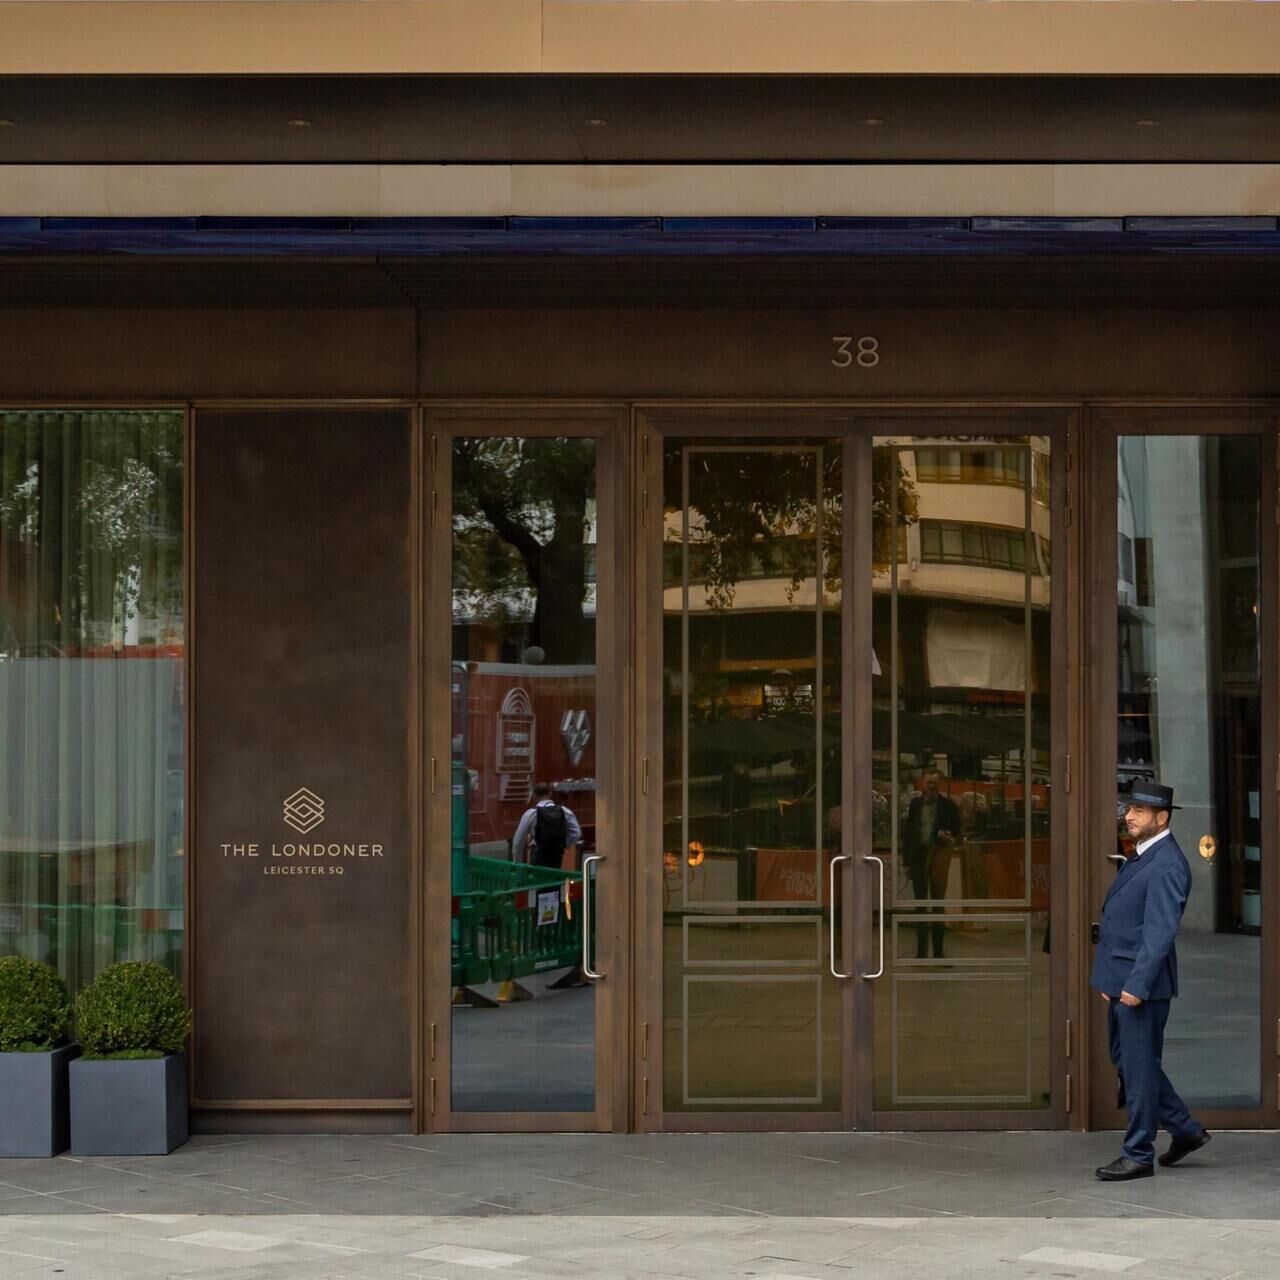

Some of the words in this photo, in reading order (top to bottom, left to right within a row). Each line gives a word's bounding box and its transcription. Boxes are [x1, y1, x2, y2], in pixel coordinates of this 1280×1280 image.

[831, 336, 880, 368] 38
[220, 844, 259, 857] THE
[272, 843, 384, 857] LONDONER
[263, 866, 325, 875] LEICESTER
[329, 866, 344, 875] SQ
